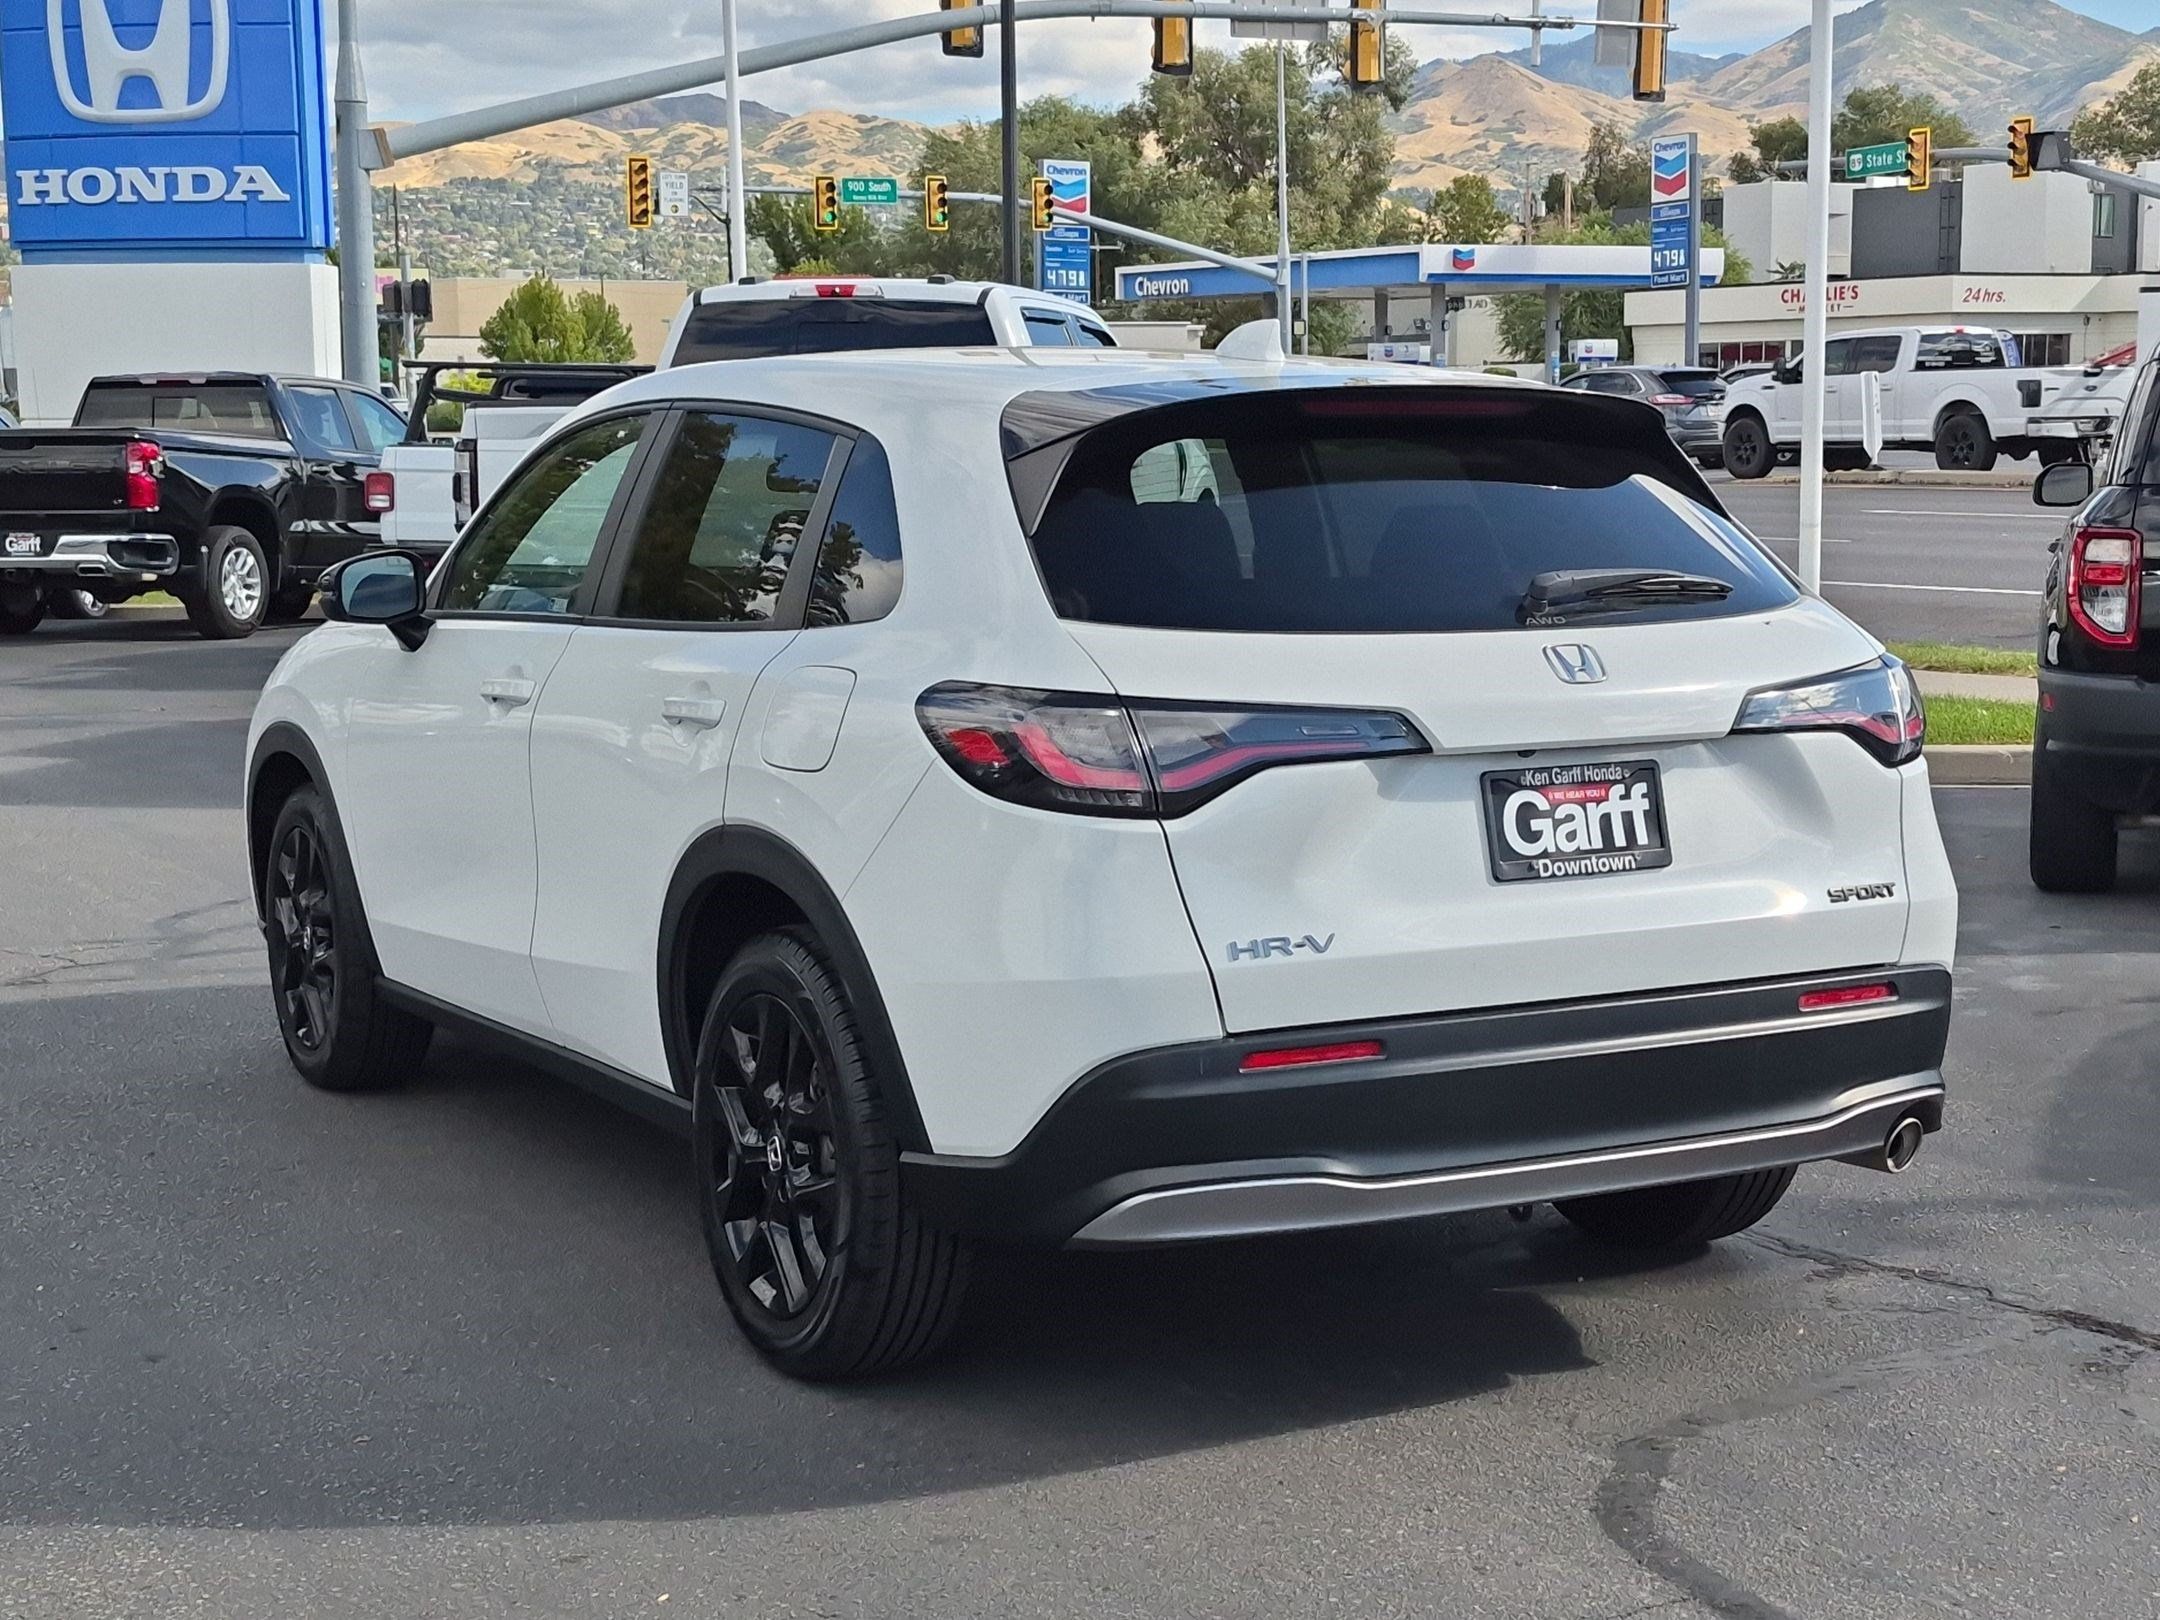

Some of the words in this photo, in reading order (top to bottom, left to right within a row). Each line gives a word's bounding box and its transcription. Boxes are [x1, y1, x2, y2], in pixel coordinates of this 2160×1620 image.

[1653, 141, 1687, 153] Chevron
[1866, 152, 1893, 168] State
[1896, 149, 1906, 163] St
[1046, 164, 1087, 176] Chevron
[15, 165, 291, 205] HONDA
[847, 181, 865, 192] 900
[868, 181, 892, 192] South
[1134, 276, 1189, 297] Chevron
[1781, 285, 1859, 304] CHLIE'S
[1962, 287, 1981, 303] 24
[1982, 288, 2006, 303] hrs.
[5, 536, 41, 553] Garff
[1525, 616, 1567, 626] AWD
[1525, 769, 1550, 787] Ken
[1552, 767, 1582, 785] Garff
[1584, 764, 1623, 782] Honda
[1566, 790, 1585, 799] HEAR
[1585, 789, 1600, 798] YOU
[1503, 782, 1650, 857] Garff
[1538, 854, 1636, 878] Downtown
[1826, 882, 1896, 903] SPORT
[1226, 932, 1335, 962] HR-V
